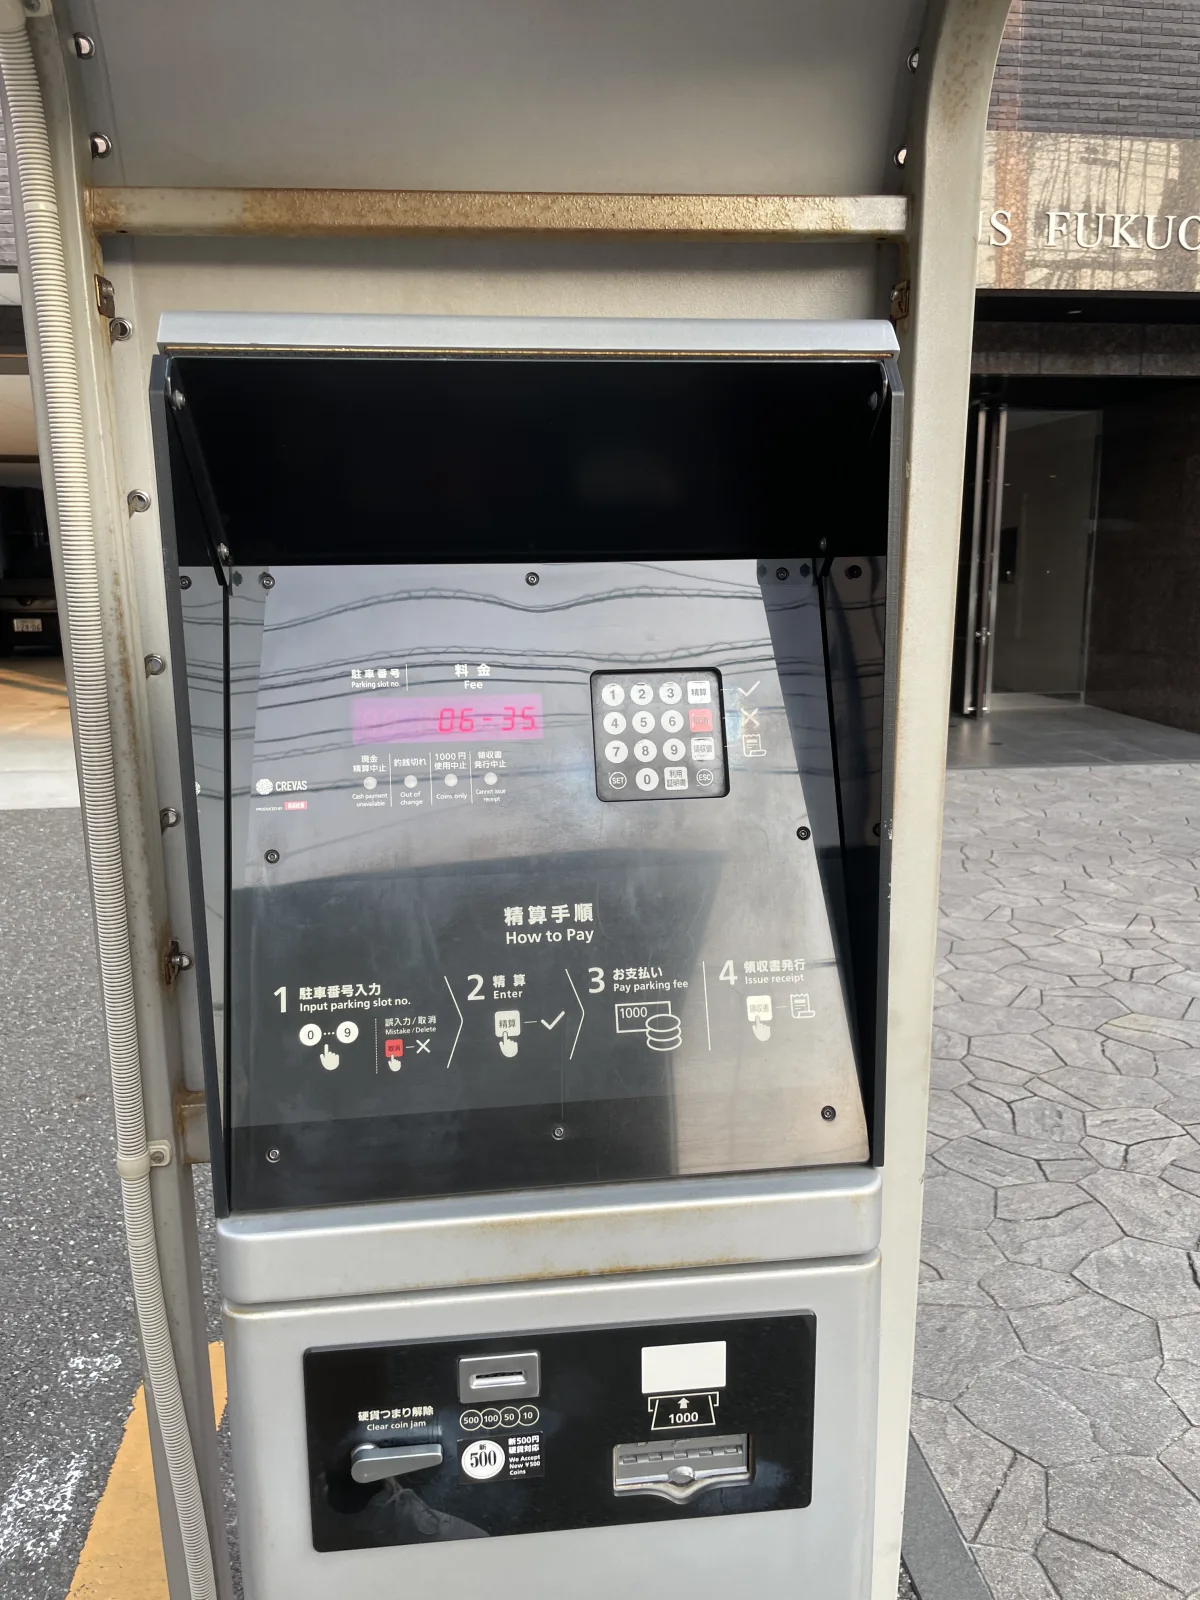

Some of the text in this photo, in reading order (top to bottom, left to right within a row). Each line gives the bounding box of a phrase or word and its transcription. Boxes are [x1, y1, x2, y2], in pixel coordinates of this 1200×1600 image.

[978, 209, 1012, 247] S
[351, 668, 400, 679] 駐車番号
[454, 663, 491, 677] 料金
[351, 680, 401, 690] Parking slot no.
[464, 680, 484, 689] Fee
[437, 706, 537, 733] 06-35
[361, 755, 378, 764] 現金
[611, 776, 625, 785] SET
[698, 773, 712, 781] ESC
[275, 780, 308, 791] CREVAS
[504, 903, 594, 926] 精算手順
[506, 928, 594, 944] How to Pay
[719, 959, 738, 985] 4
[743, 958, 806, 974] 領収書発行
[588, 967, 605, 994] 3
[612, 966, 663, 981] お支払い
[744, 972, 805, 985] Issue receipt
[467, 974, 485, 1001] 2
[492, 974, 526, 988] 精算
[613, 979, 689, 993] Pay parking fee
[299, 983, 381, 1001] 駐車番号入力
[493, 990, 523, 999] Enter
[273, 986, 287, 1013] 1
[300, 997, 411, 1013] Input parking slot no.
[619, 1006, 648, 1019] 1000
[499, 1018, 516, 1028] 精算
[307, 1030, 314, 1040] 0
[358, 1405, 434, 1421] 硬貨つまり解除
[463, 1411, 533, 1425] 500 100 50 10
[668, 1412, 699, 1424] 1000
[366, 1420, 427, 1431] Clear coin jam
[508, 1435, 540, 1446] 新500円
[508, 1444, 540, 1454] 硬貨対応
[470, 1450, 497, 1468] 500
[520, 1454, 541, 1462] Accept
